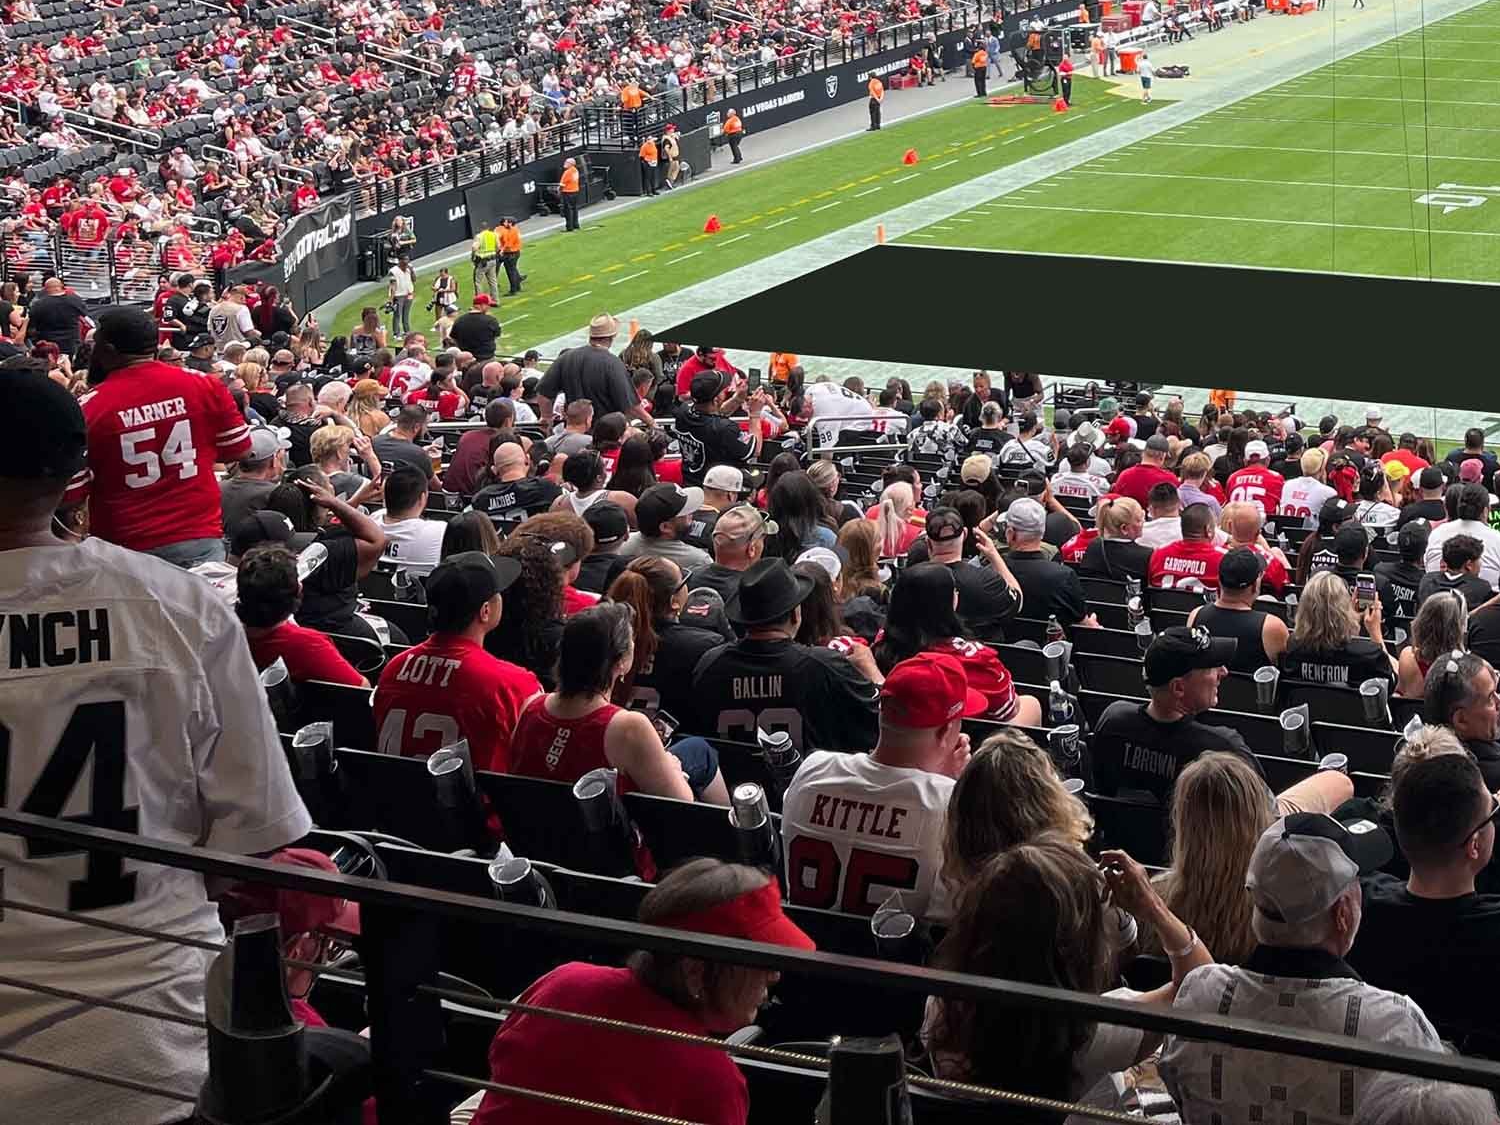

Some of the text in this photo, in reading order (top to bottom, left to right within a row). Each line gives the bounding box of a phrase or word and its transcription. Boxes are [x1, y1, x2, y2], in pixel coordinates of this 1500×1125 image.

[743, 90, 805, 117] LAS VEGAS RAIDERS
[448, 204, 466, 222] LAS
[118, 396, 188, 429] WARNER
[120, 419, 198, 490] 54
[487, 491, 517, 510] JACOBS
[1163, 555, 1207, 574] GAROPPOLO
[0, 608, 112, 670] NCH
[396, 653, 461, 688] LOTT
[1301, 661, 1350, 685] RENFROW
[732, 674, 783, 700] BALLIN
[1122, 742, 1178, 781] T.BROWN
[808, 792, 908, 840] KITTLE
